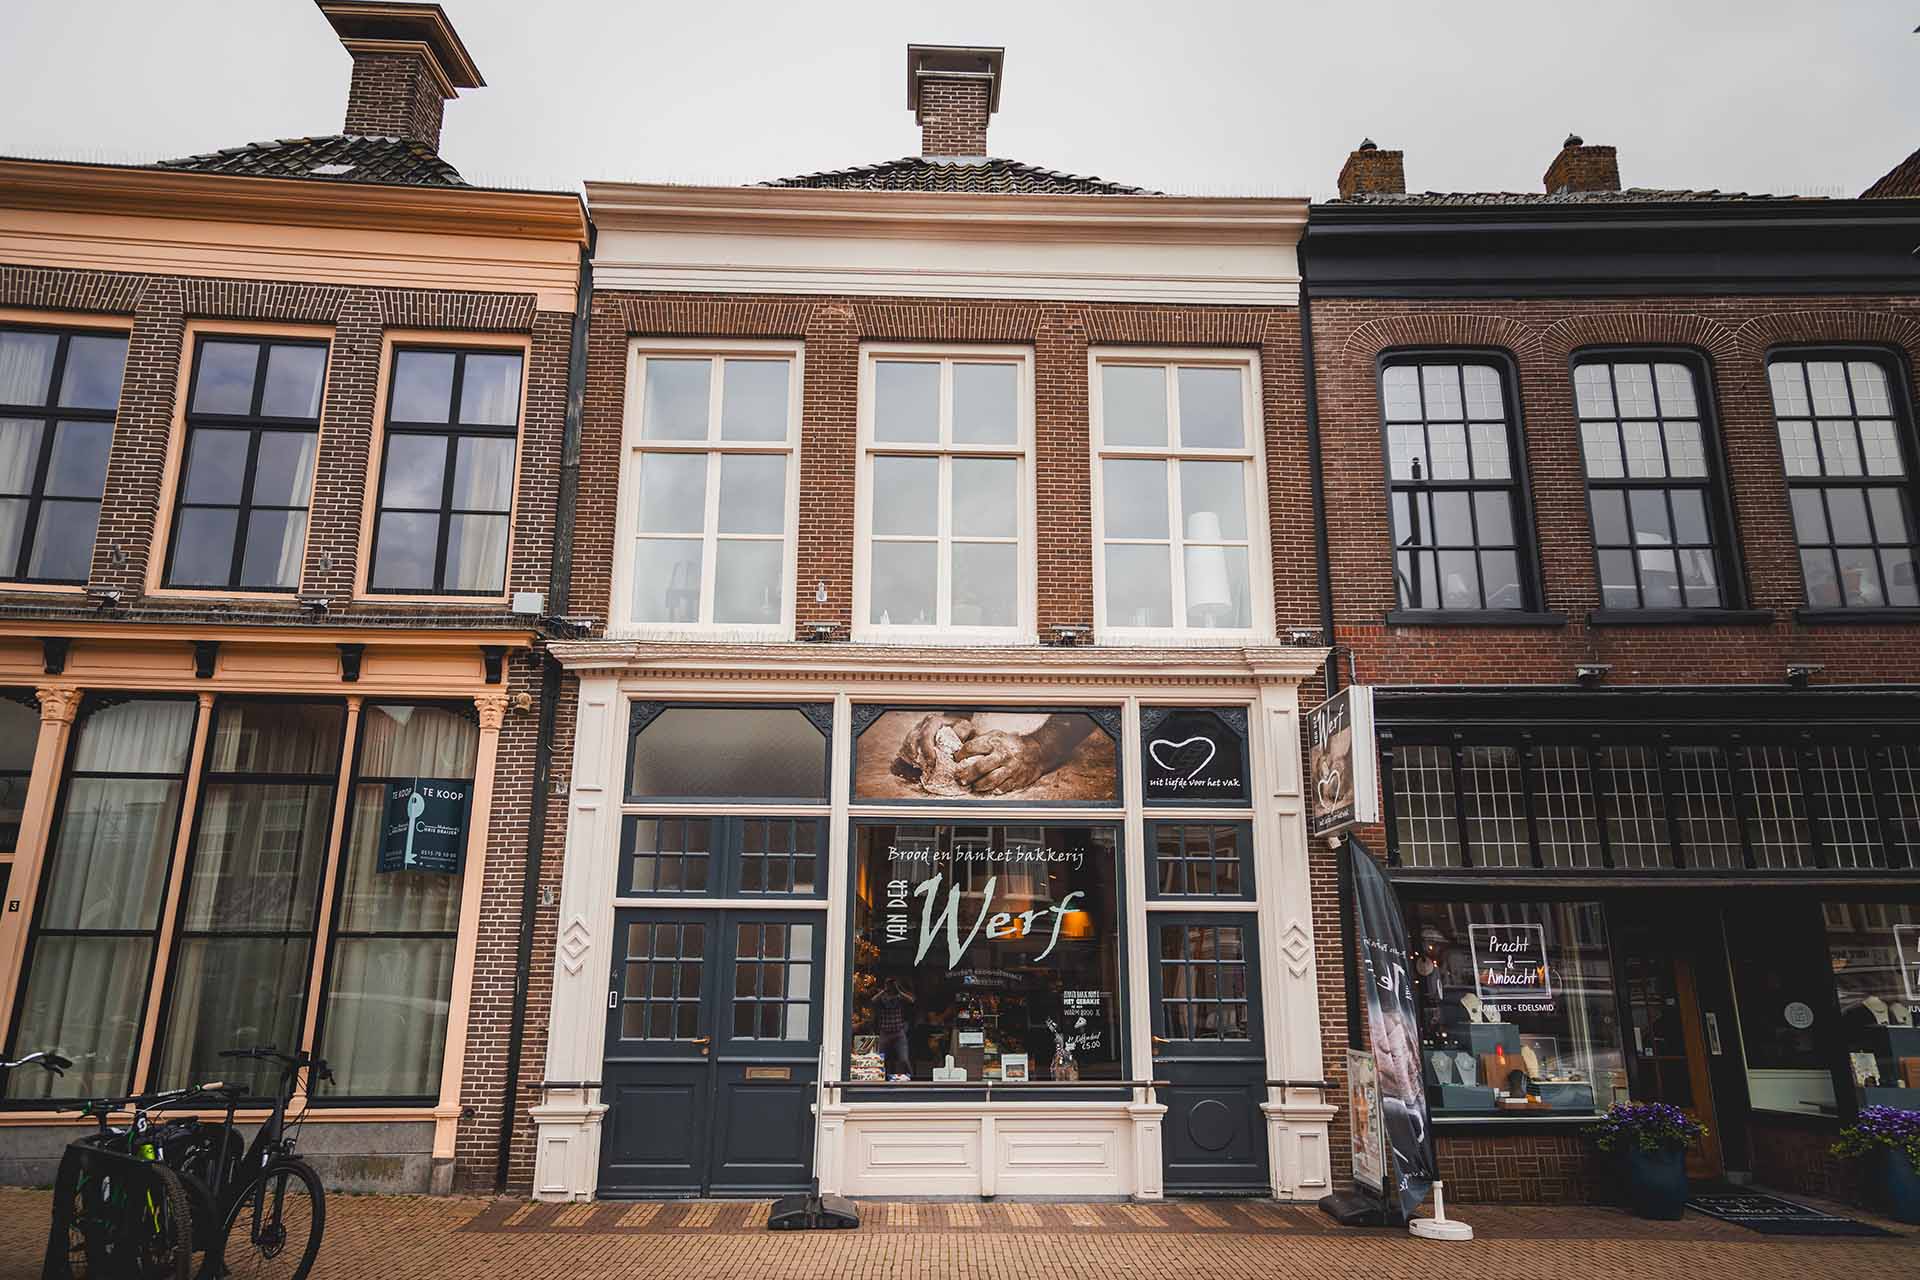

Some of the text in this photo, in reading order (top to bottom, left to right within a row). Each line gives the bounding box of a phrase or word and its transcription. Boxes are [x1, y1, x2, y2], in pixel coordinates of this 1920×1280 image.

[1316, 703, 1344, 750] Werf
[1150, 777, 1241, 791] uit liefde voor het vak
[423, 787, 464, 801] TE KOOP
[887, 845, 1085, 871] Brood en banket bakkerij
[886, 879, 909, 944] VAN DER
[914, 872, 1085, 970] Werf
[1489, 935, 1529, 952] Pracht
[1507, 954, 1514, 969] &
[1487, 967, 1537, 985] Ambacht
[1479, 1003, 1513, 1012] UWELIER
[1518, 1003, 1554, 1012] EDELSMID
